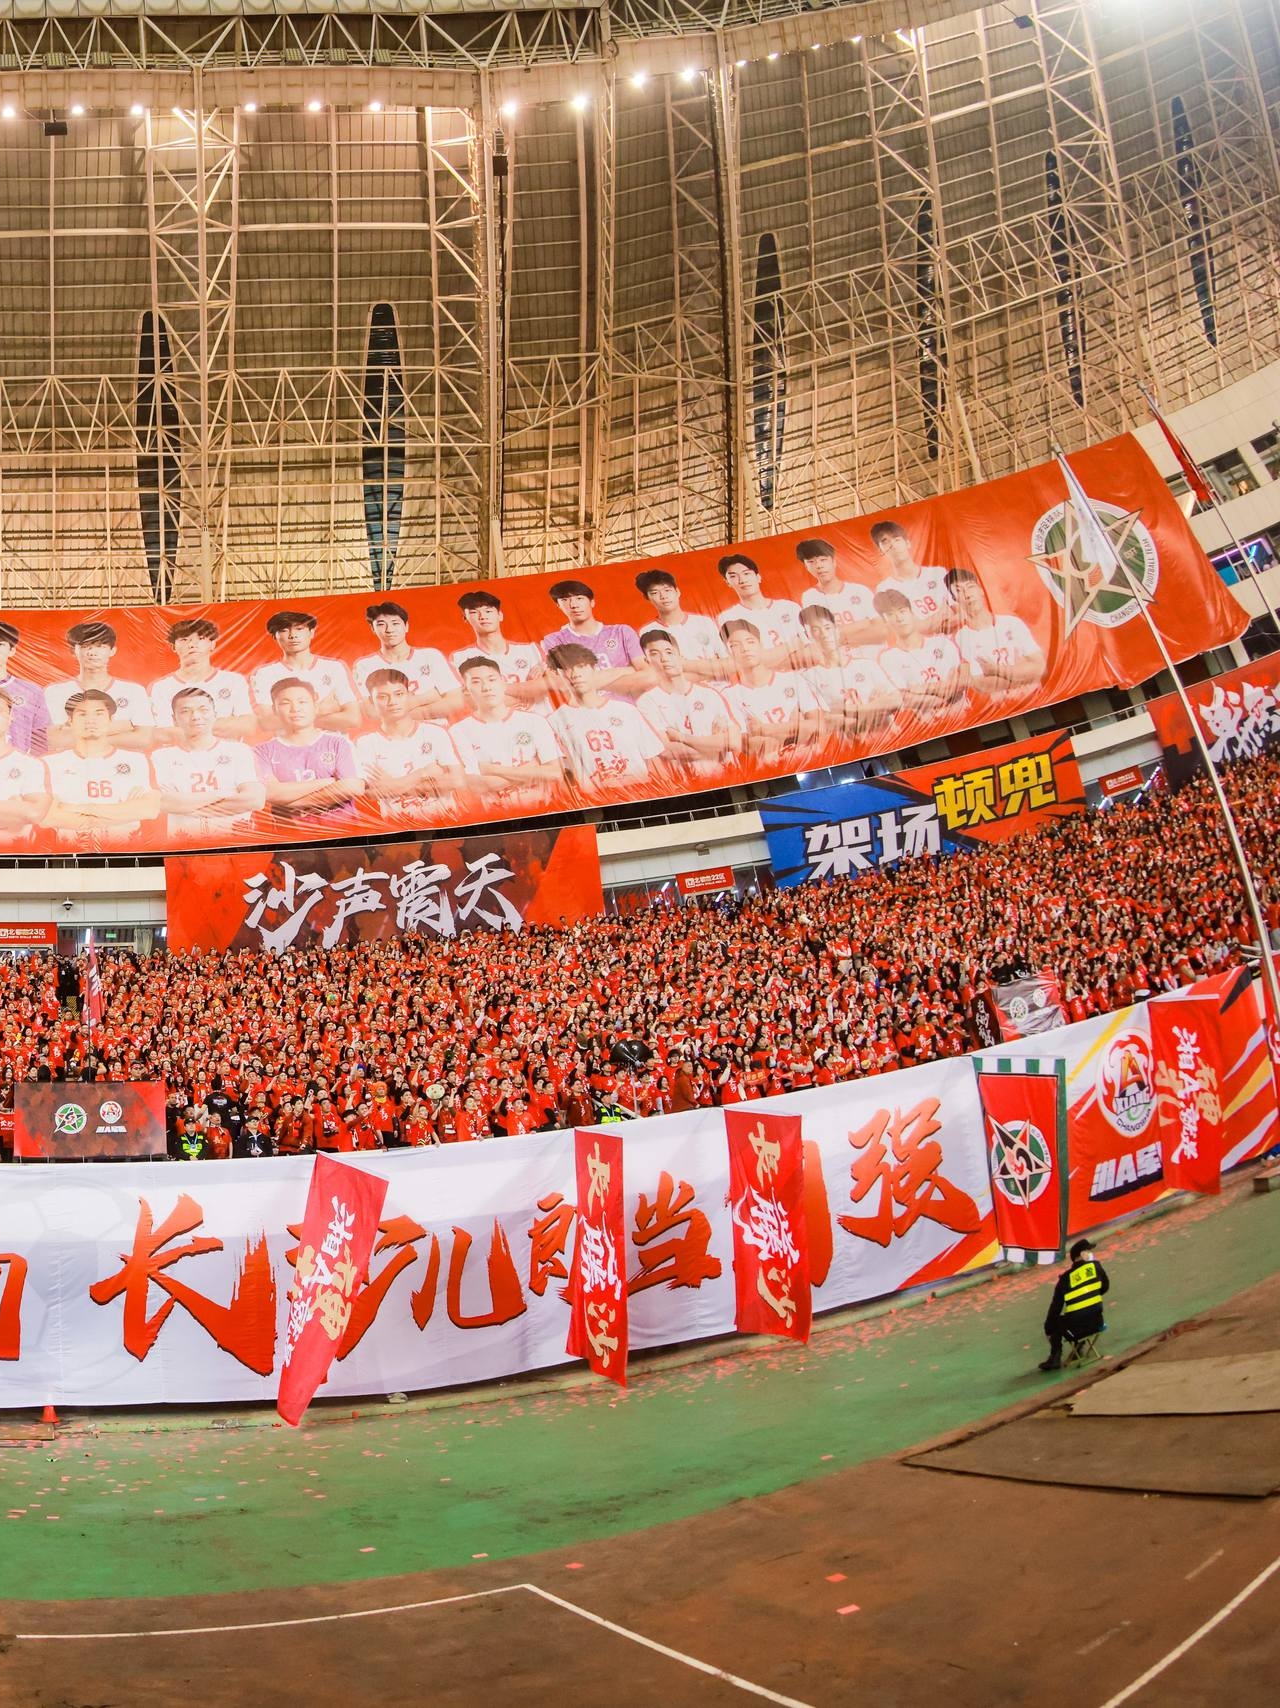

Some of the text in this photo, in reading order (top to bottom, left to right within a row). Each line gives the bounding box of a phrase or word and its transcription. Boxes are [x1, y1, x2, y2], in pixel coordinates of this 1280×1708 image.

[86, 779, 114, 799] 66
[190, 769, 220, 793] 24
[243, 852, 525, 950] 沙声震天
